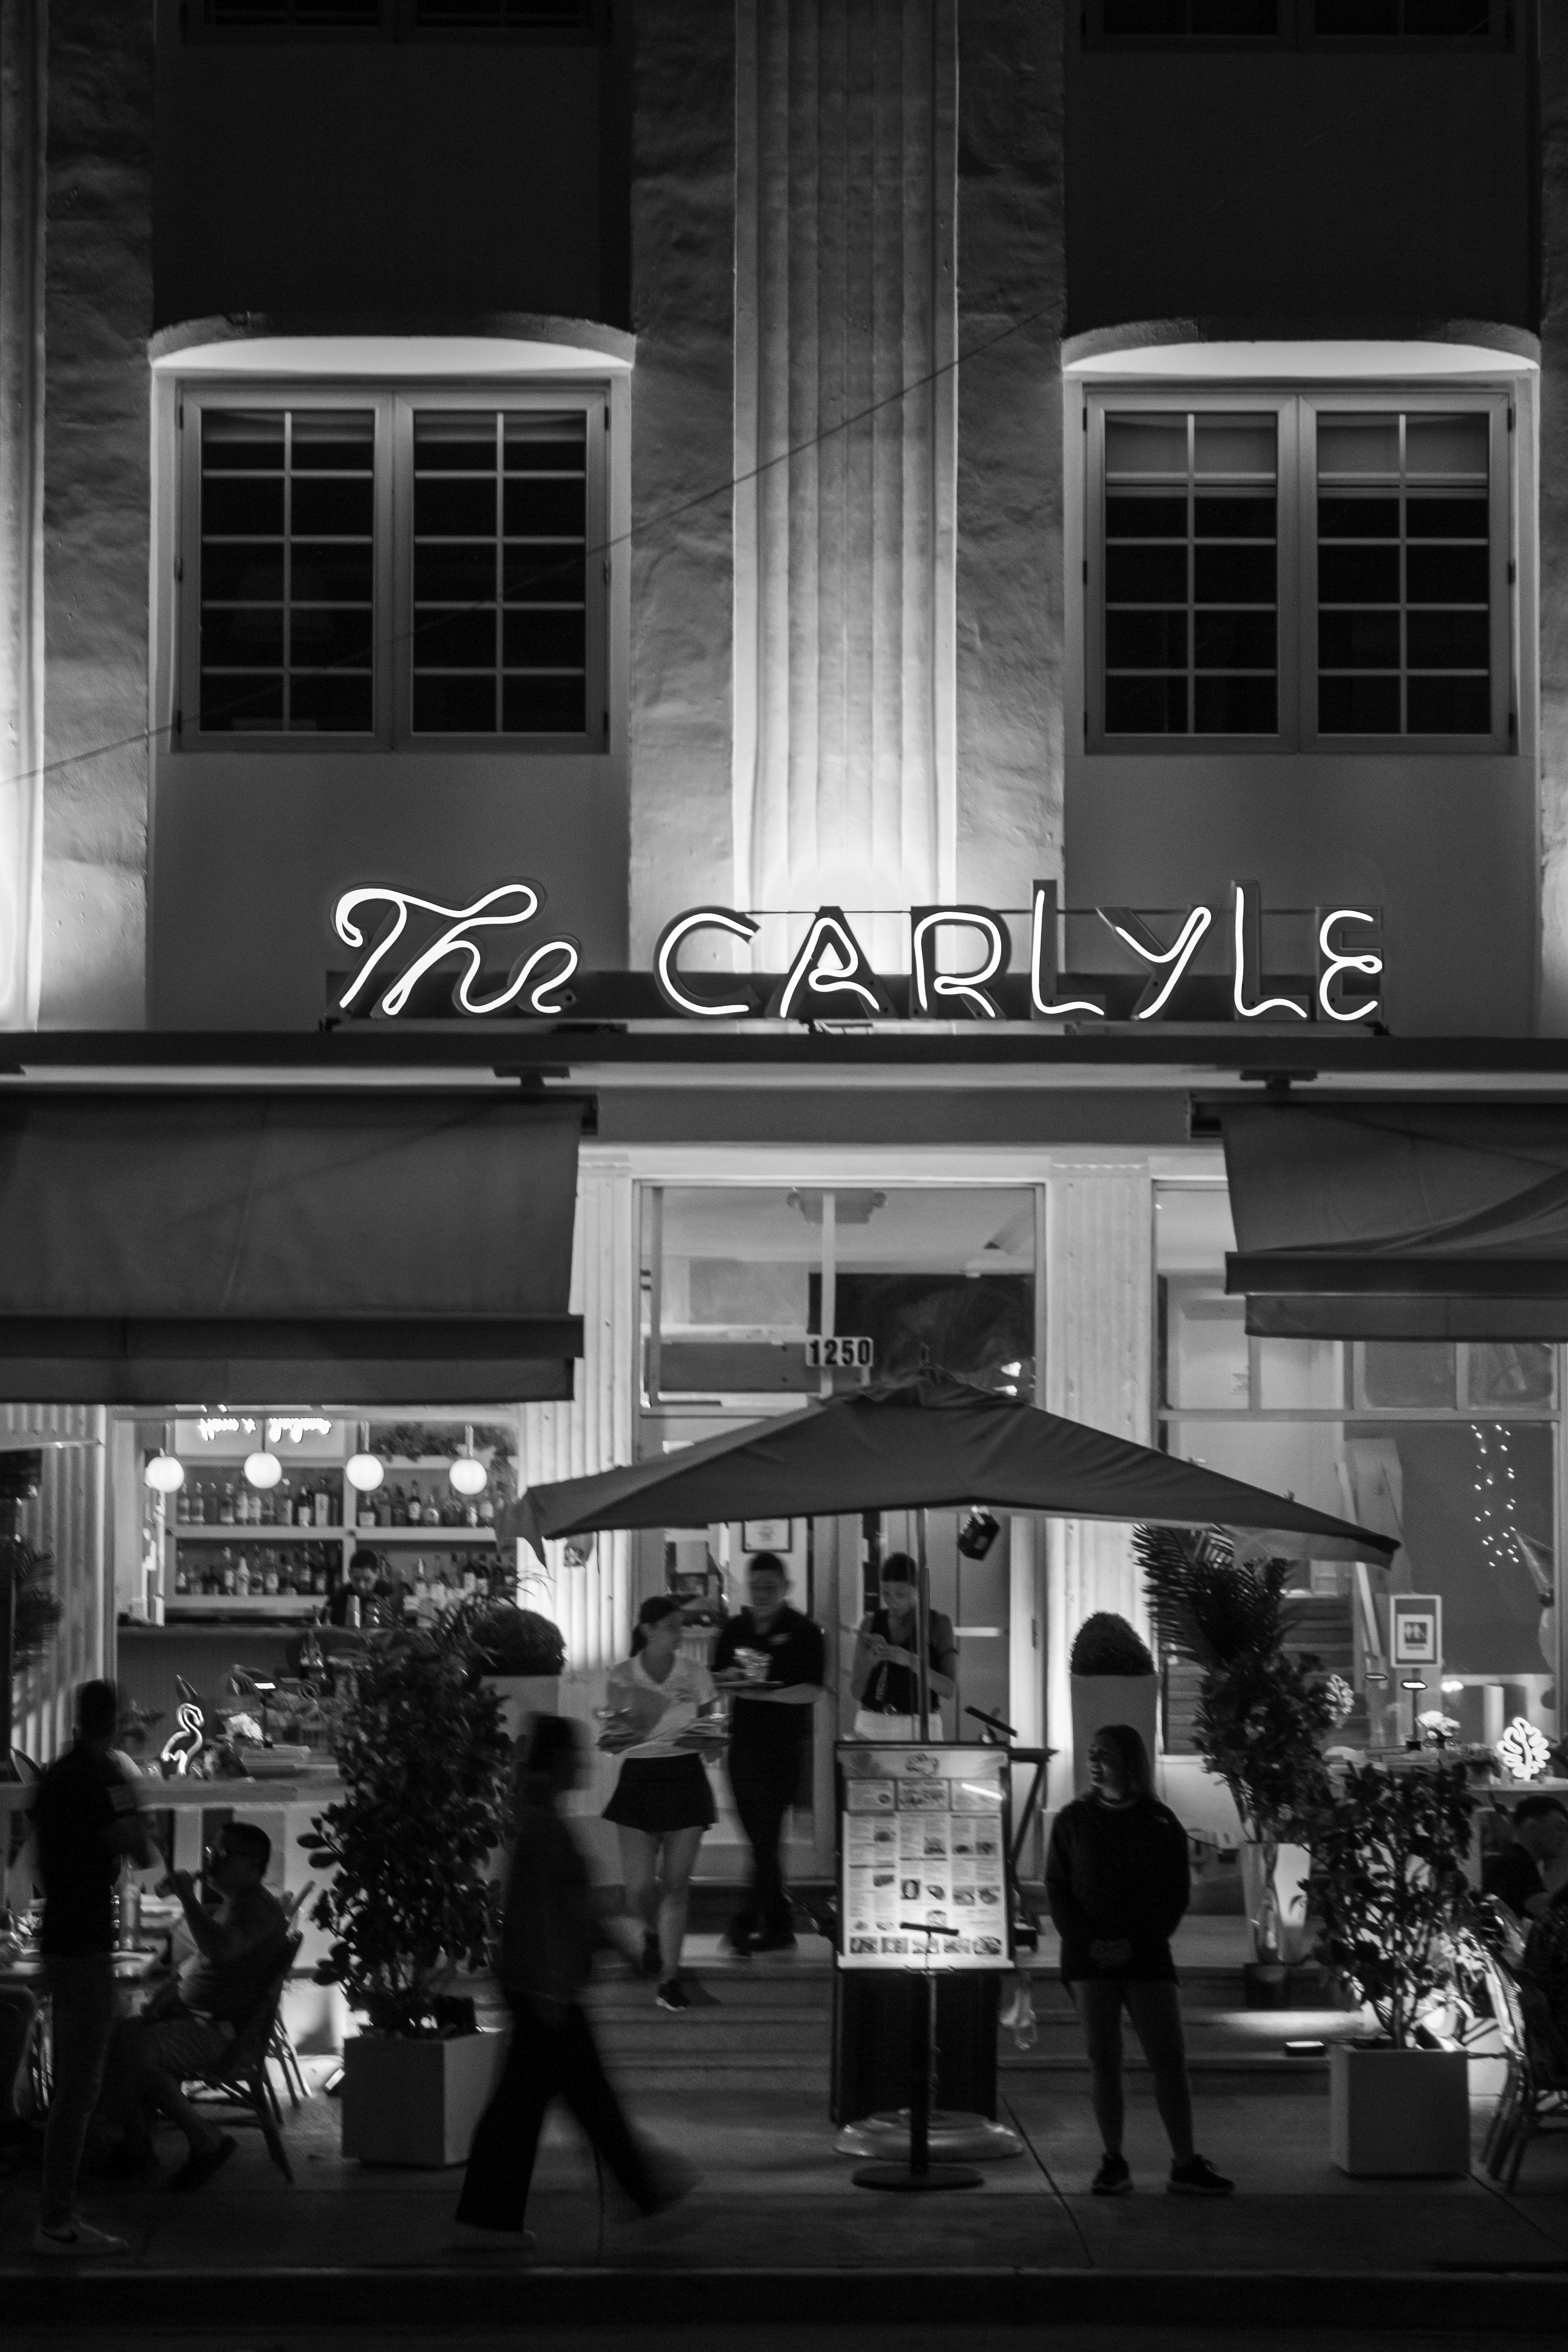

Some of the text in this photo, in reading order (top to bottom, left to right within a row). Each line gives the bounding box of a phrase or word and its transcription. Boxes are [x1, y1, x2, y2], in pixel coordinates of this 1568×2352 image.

[327, 878, 1383, 1021] The CARLYLE
[809, 1339, 870, 1365] 1250
